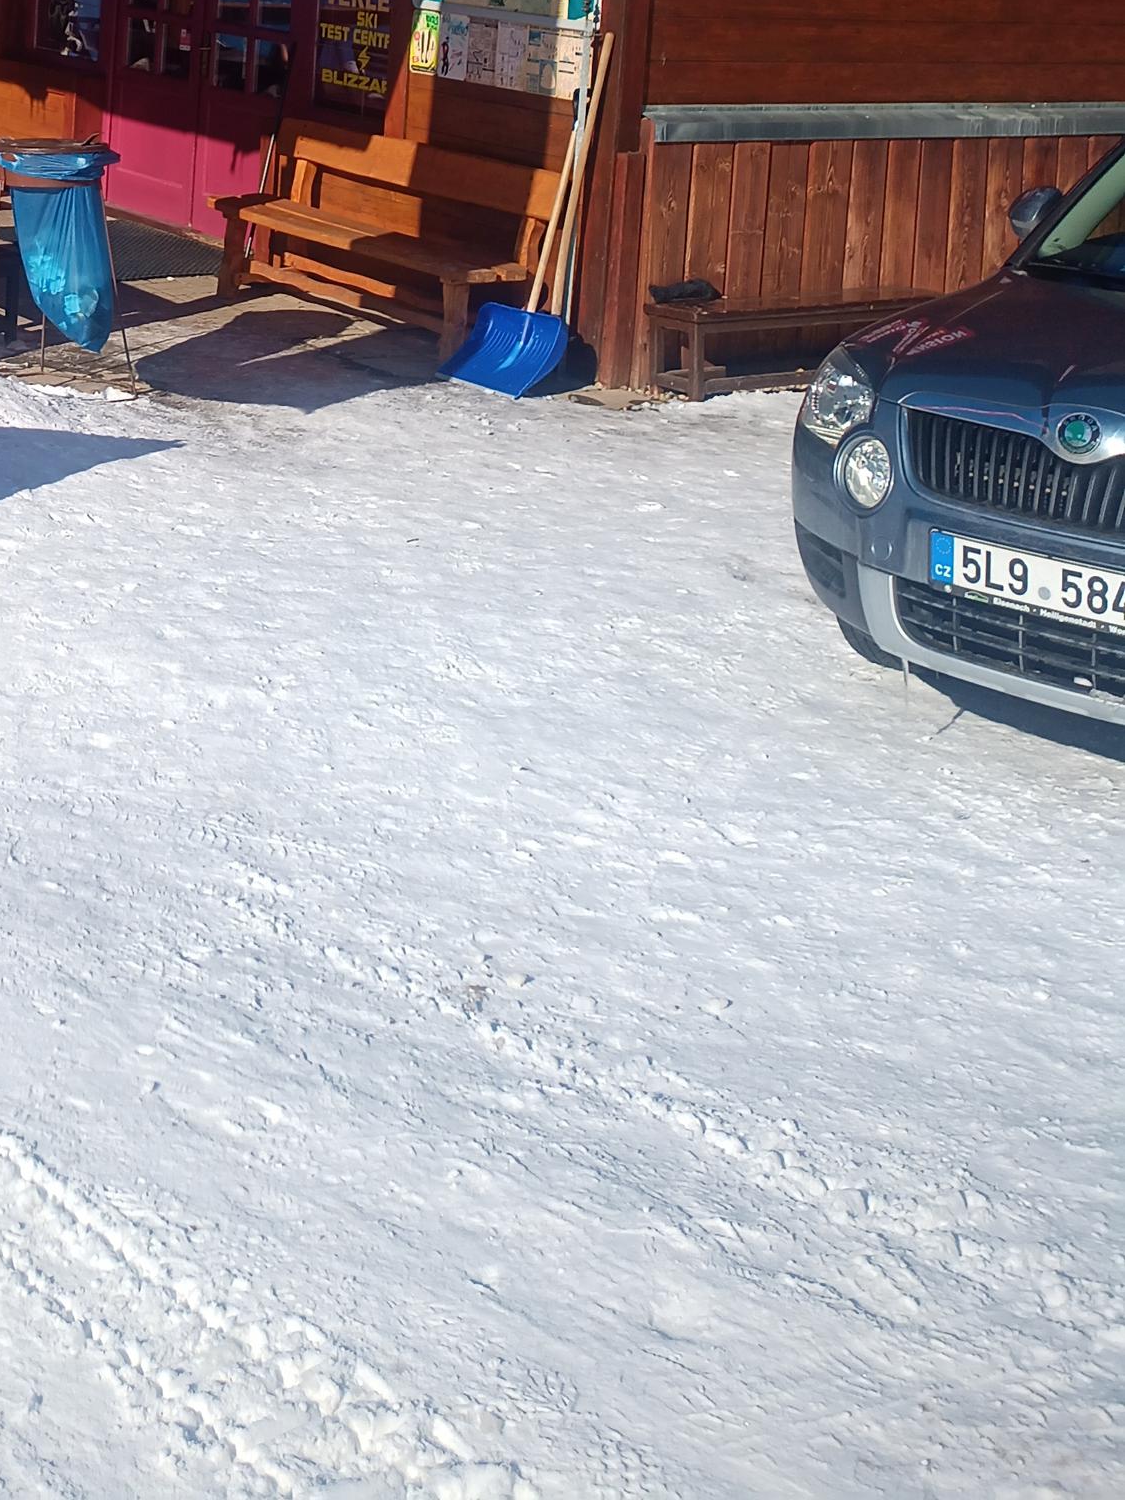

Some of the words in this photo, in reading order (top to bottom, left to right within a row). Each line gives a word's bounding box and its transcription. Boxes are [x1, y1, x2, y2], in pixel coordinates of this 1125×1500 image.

[356, 11, 378, 29] SKI
[319, 22, 350, 42] TEST
[935, 563, 951, 578] CZ
[962, 545, 1028, 595] 5L9
